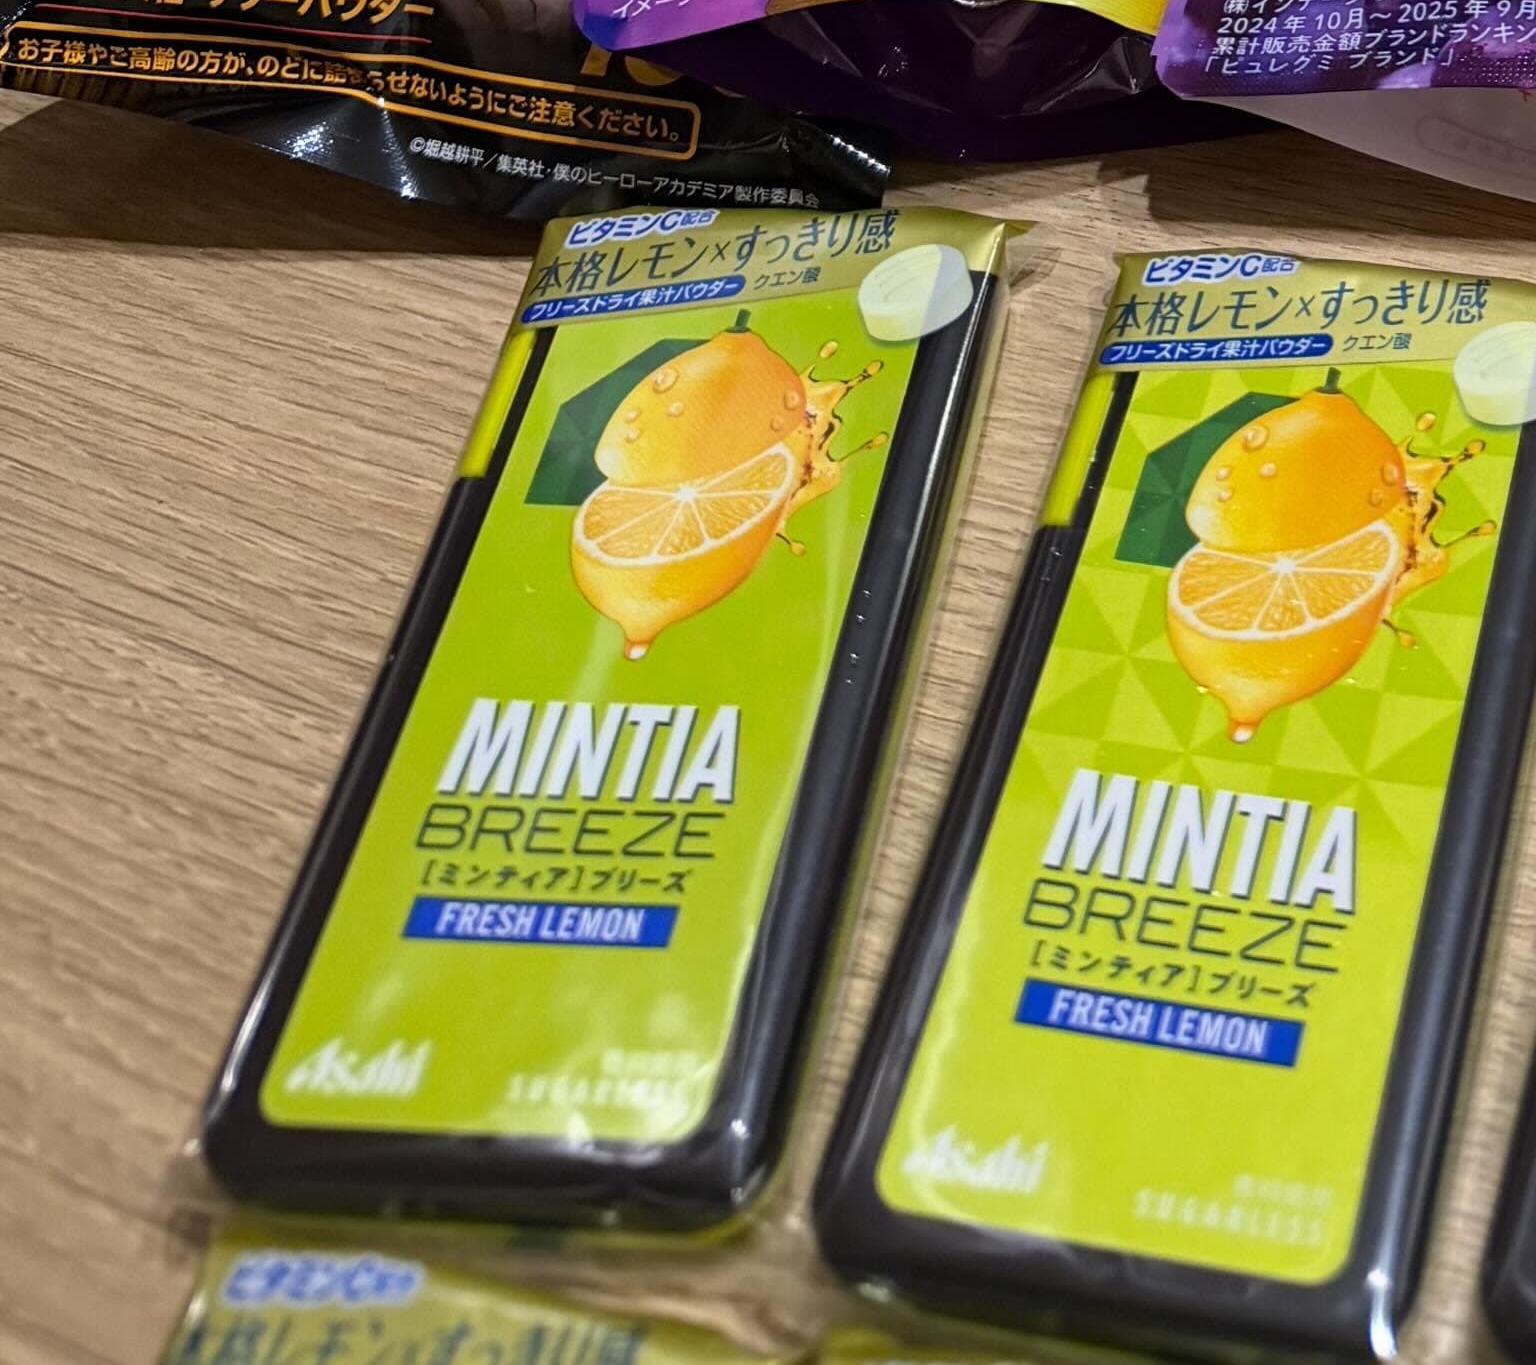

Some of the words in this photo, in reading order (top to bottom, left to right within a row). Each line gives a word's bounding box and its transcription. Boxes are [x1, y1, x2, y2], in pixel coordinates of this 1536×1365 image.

[528, 209, 899, 298] 本格レモン×すっきり感
[571, 211, 717, 246] ビタミンC配合
[529, 281, 741, 321] フリーズドライ果汁パウダー
[753, 266, 823, 292] クエン酸
[1144, 253, 1298, 284] ビタミンC配合
[1107, 276, 1492, 339] 本格レモン×すっきり感
[1109, 335, 1330, 364] フリーズドライ果汁パウダー
[1341, 331, 1413, 354] クエン酸
[436, 697, 742, 806] MINTIA
[414, 802, 727, 862] BREEZE
[1042, 767, 1359, 917] MINTIA
[433, 900, 541, 940] FRESH
[540, 905, 646, 944] LEMON
[1022, 876, 1349, 975] BREEZE
[1047, 987, 1152, 1038] FRESH
[1157, 1004, 1269, 1059] LEMON
